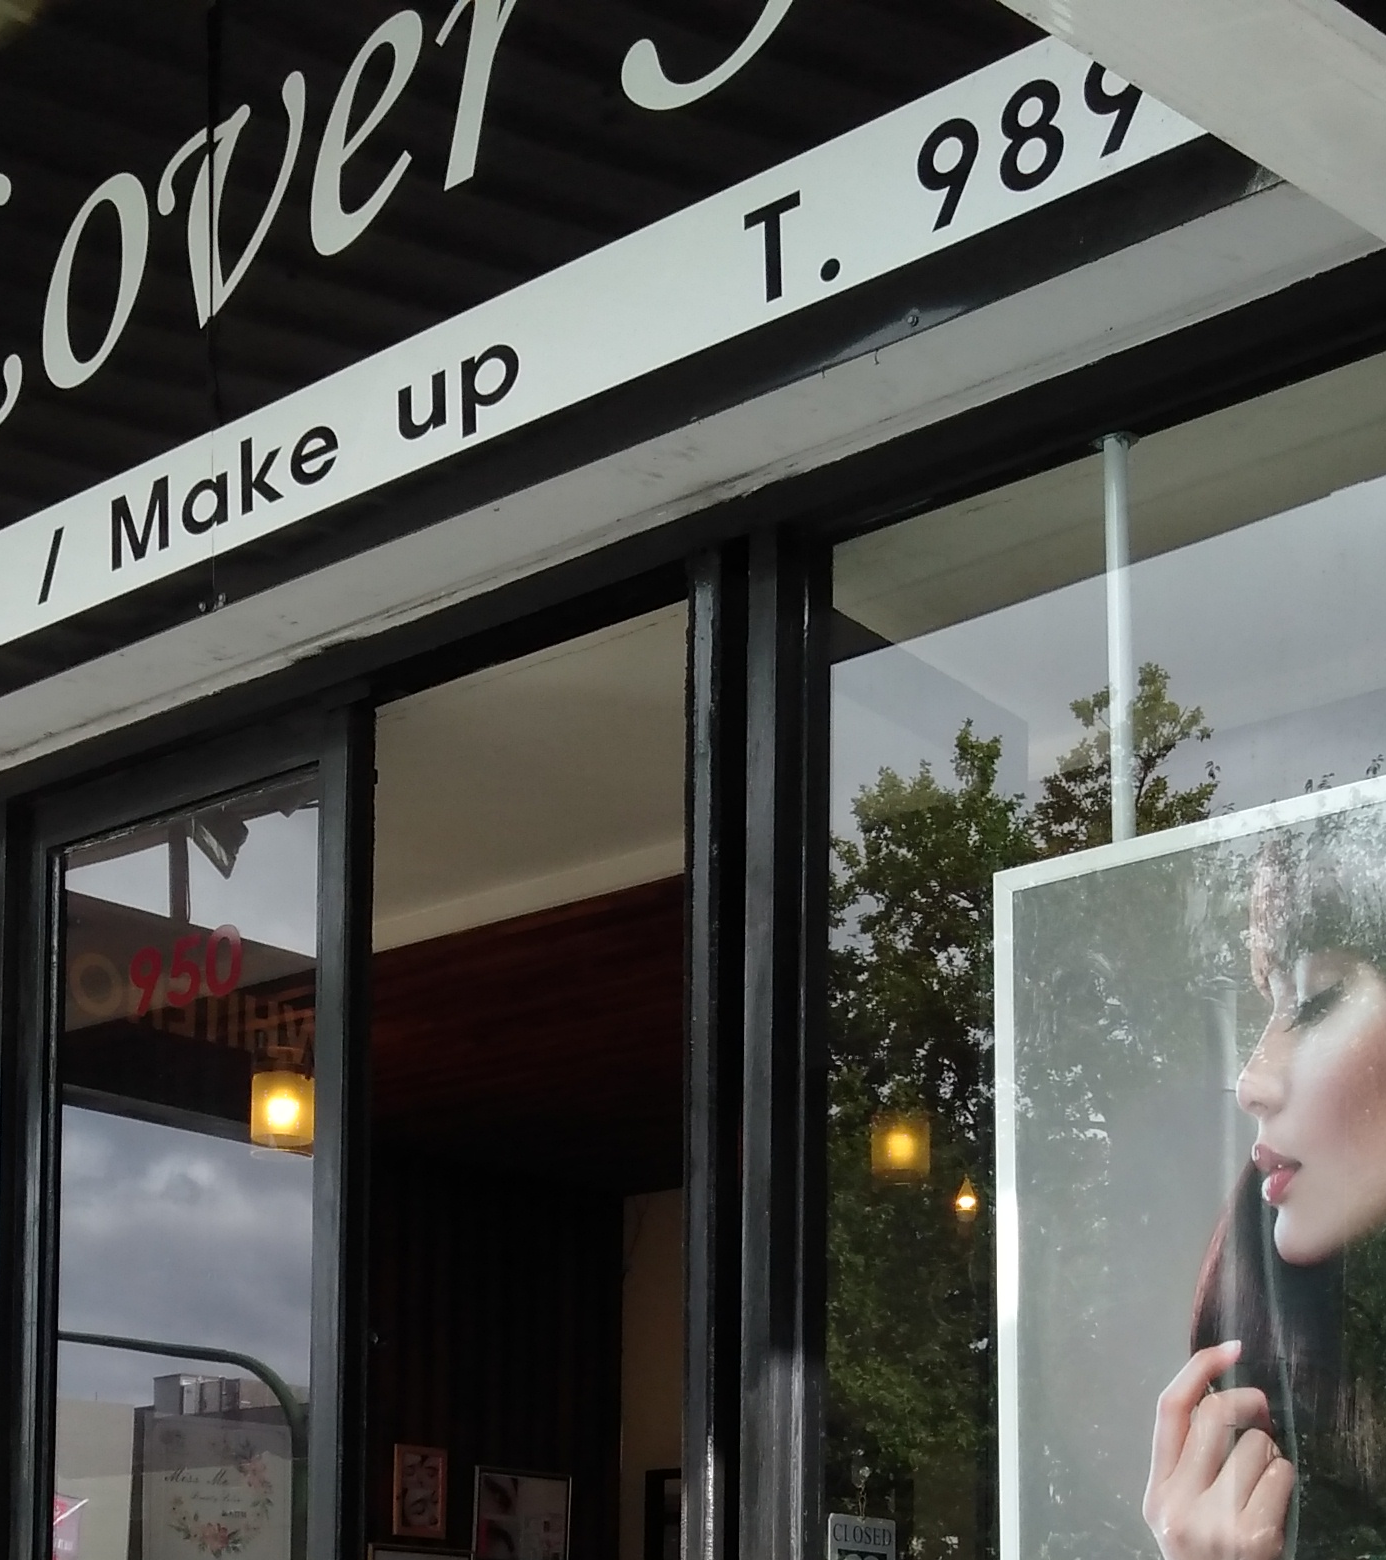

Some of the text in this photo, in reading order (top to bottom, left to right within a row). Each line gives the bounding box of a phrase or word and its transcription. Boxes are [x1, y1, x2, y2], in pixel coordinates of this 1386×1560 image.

[111, 426, 338, 572] Make
[398, 344, 519, 438] up
[744, 190, 841, 303] T.
[130, 924, 242, 1017] 950
[833, 1523, 892, 1547] CLOSED
